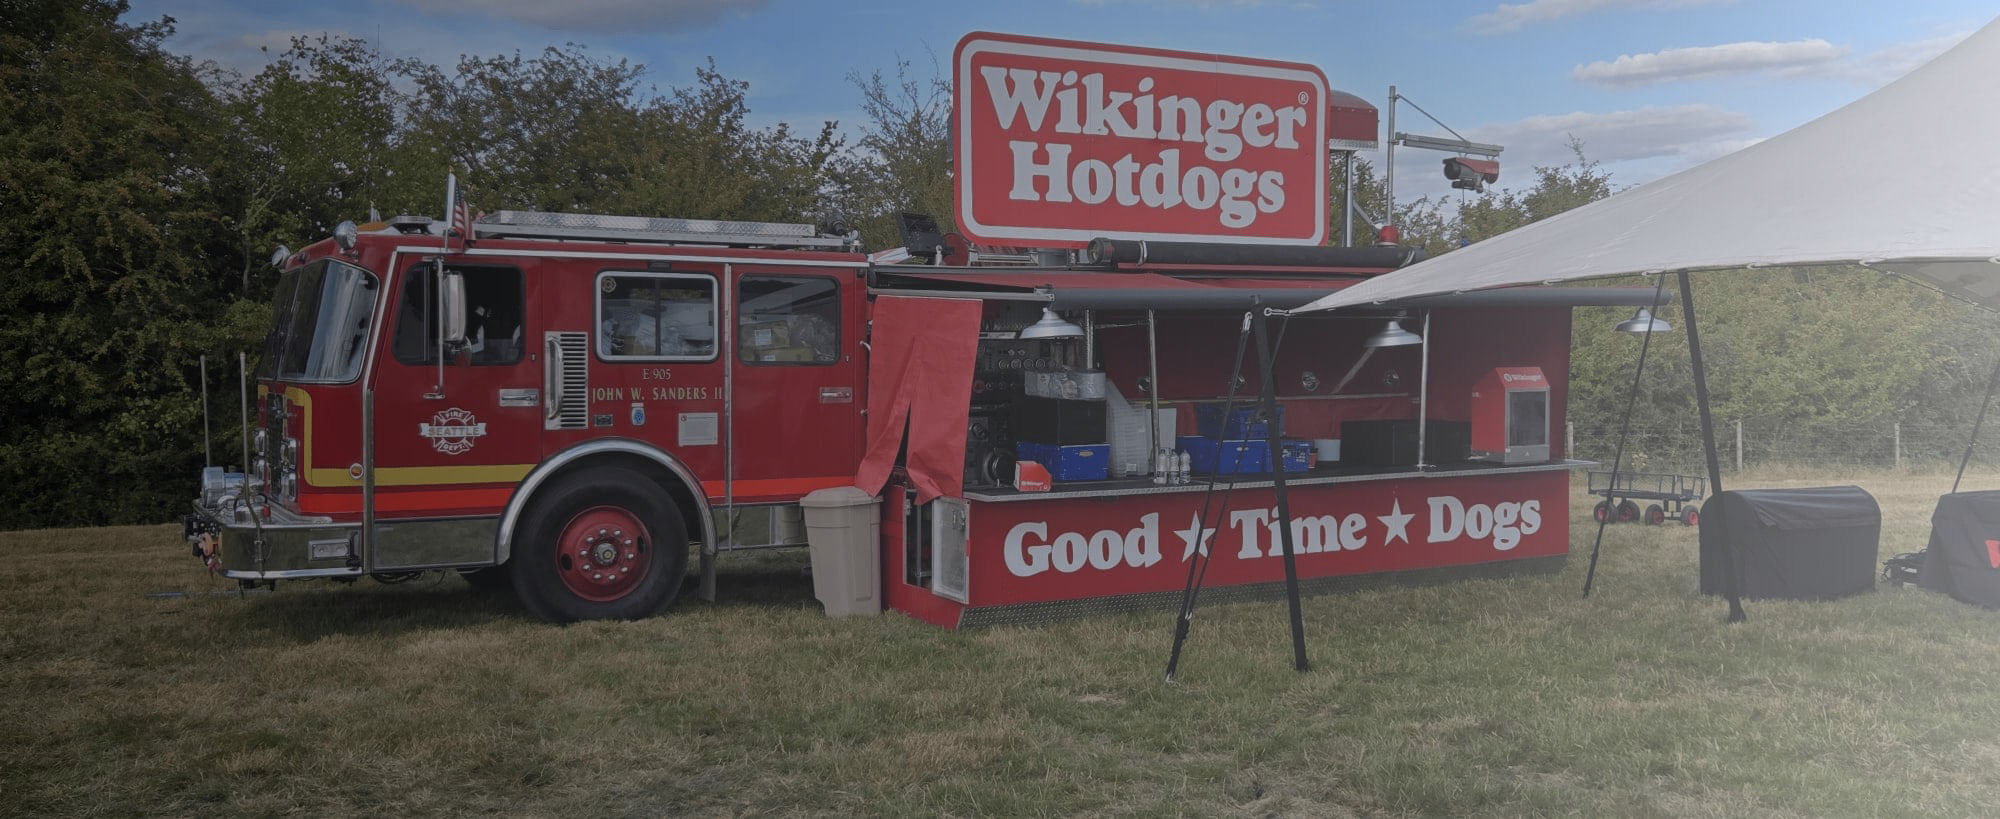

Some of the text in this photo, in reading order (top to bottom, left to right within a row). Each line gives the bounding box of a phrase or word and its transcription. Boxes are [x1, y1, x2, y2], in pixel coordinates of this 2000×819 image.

[980, 66, 1306, 162] Wikinger
[1009, 141, 1285, 228] Hotdogs
[643, 368, 671, 380] E 905
[592, 387, 623, 403] JOHN
[631, 387, 645, 400] W.
[652, 386, 707, 400] SANDERS
[445, 411, 463, 419] FIRE
[429, 427, 480, 436] SEATTLE
[1003, 495, 1542, 577] Good Time Dogs
